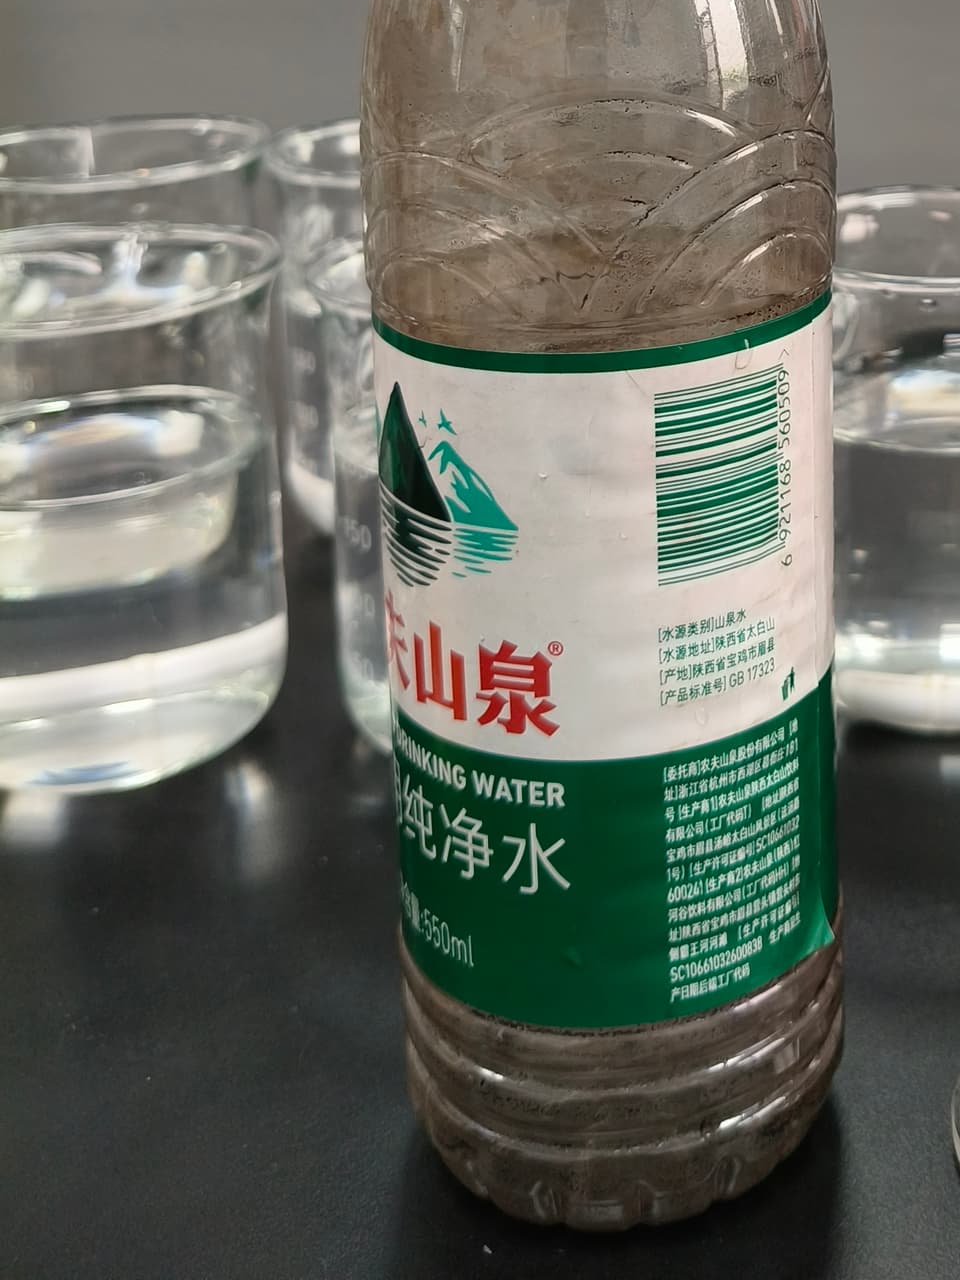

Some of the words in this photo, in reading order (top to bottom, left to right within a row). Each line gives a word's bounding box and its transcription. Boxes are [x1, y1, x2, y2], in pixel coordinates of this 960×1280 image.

[777, 369, 792, 450] 560509
[778, 458, 792, 542] 921168
[728, 670, 745, 688] GB
[747, 656, 776, 681] 17323
[472, 769, 566, 809] WATER
